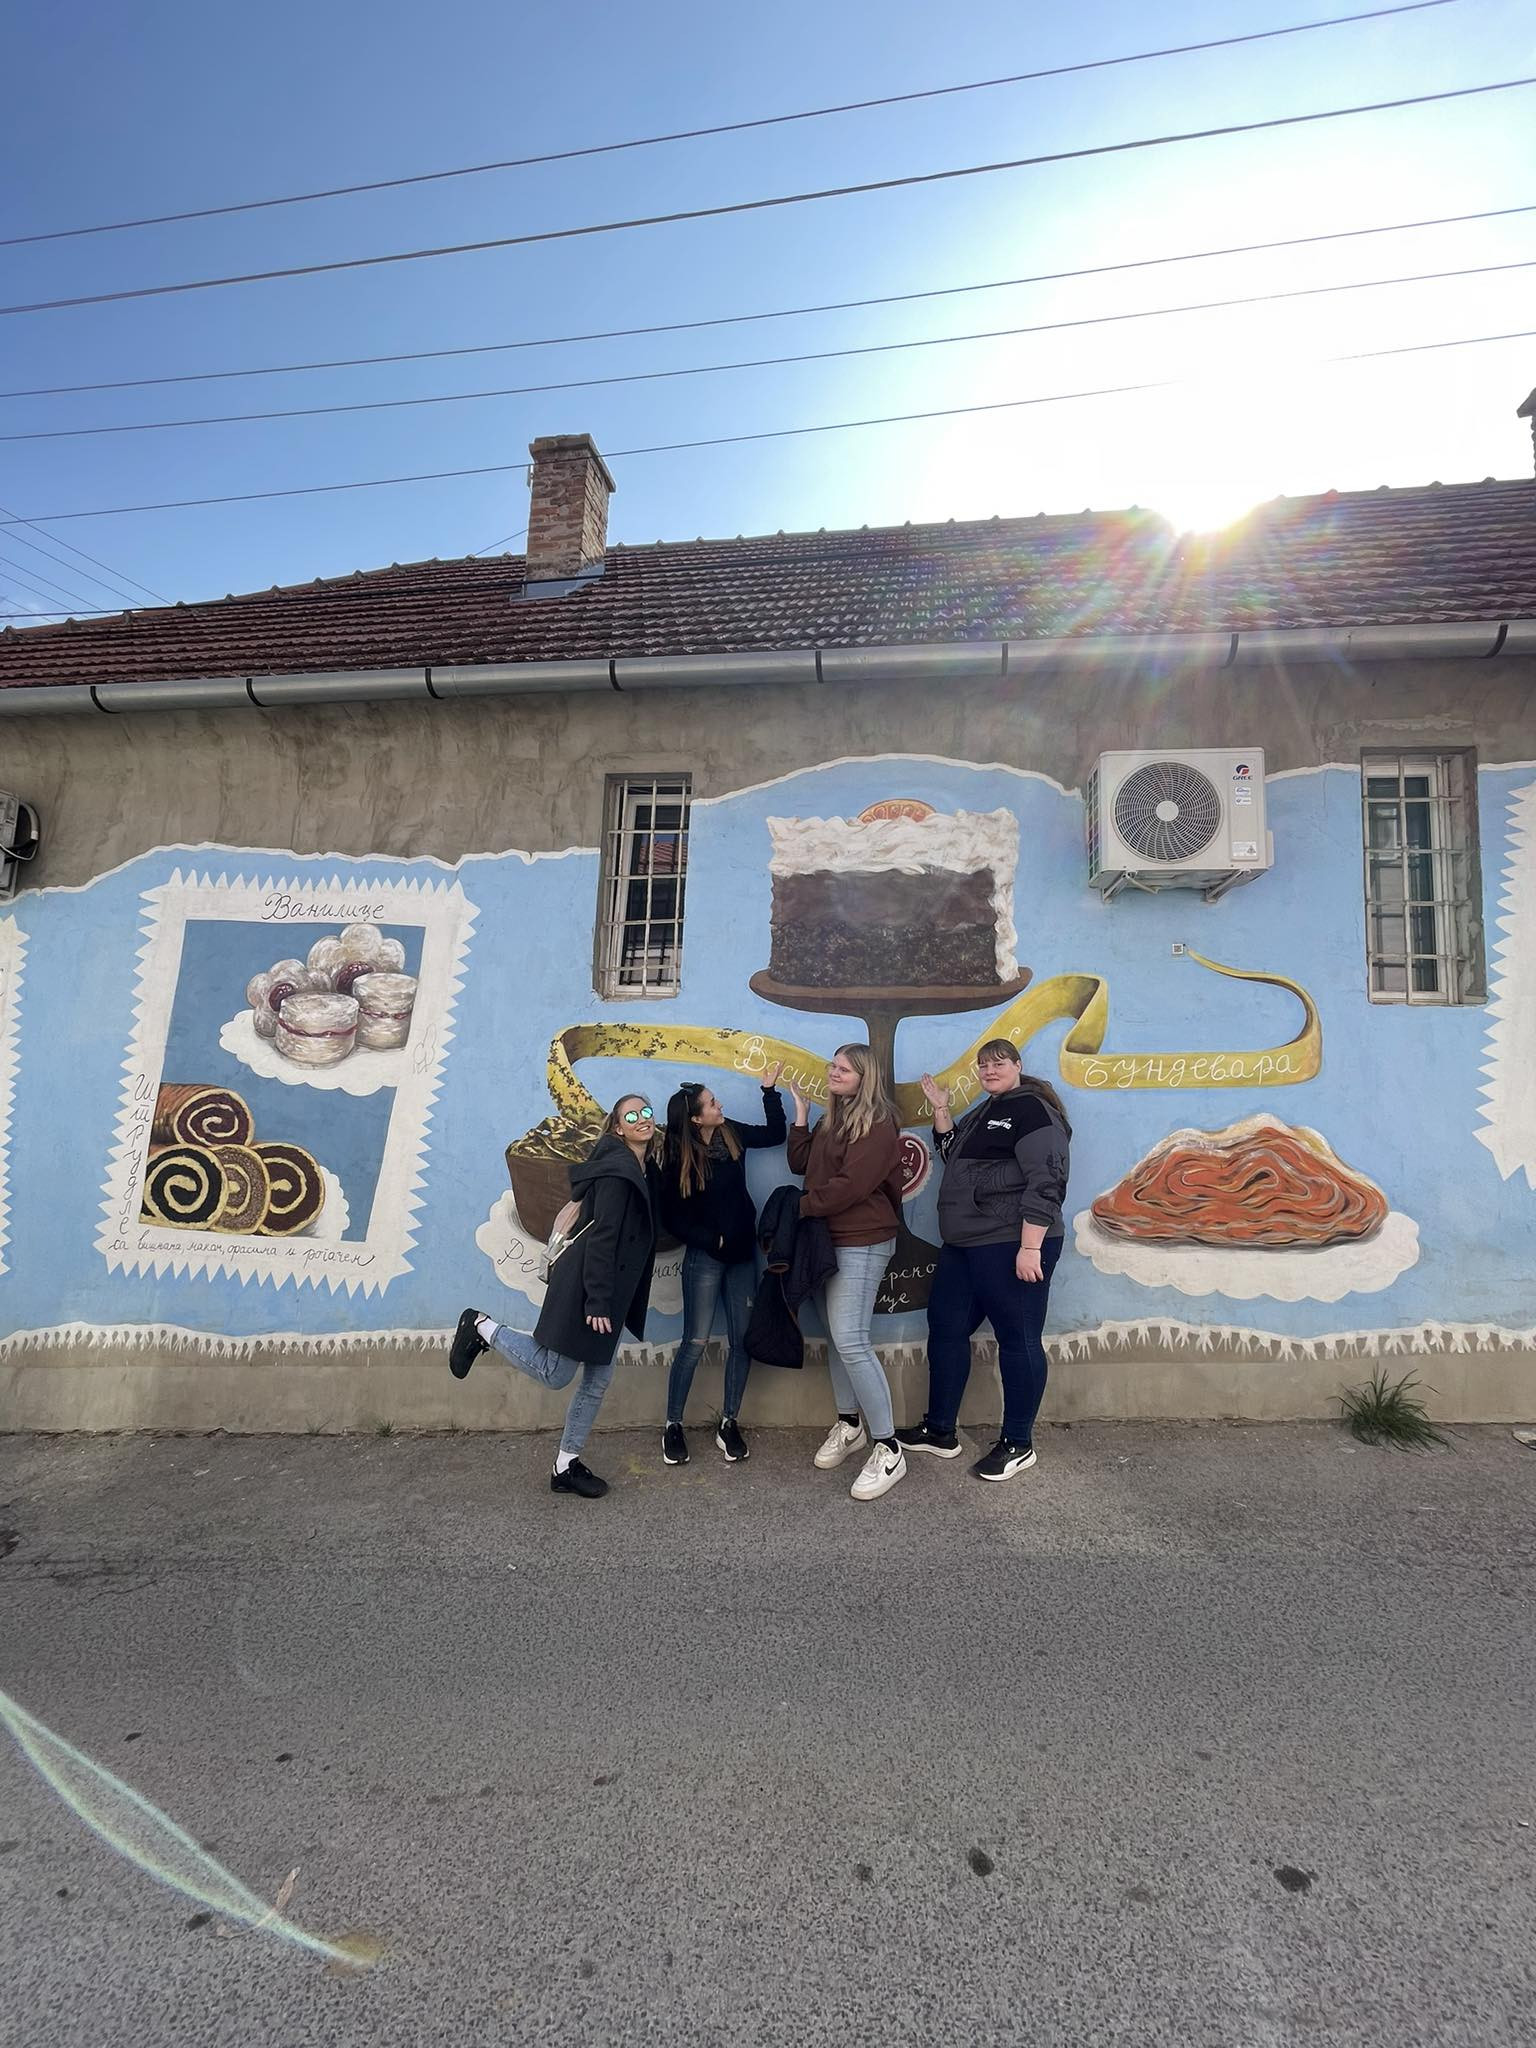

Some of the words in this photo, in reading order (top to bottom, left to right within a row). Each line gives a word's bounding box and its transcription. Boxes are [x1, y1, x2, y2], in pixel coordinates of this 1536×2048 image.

[261, 892, 384, 922] Ванилице
[1081, 1054, 1301, 1089] Бундевара
[119, 1073, 156, 1235] Штрудле
[108, 1239, 129, 1251] са
[226, 1244, 278, 1262] орасима
[284, 1246, 297, 1256] и
